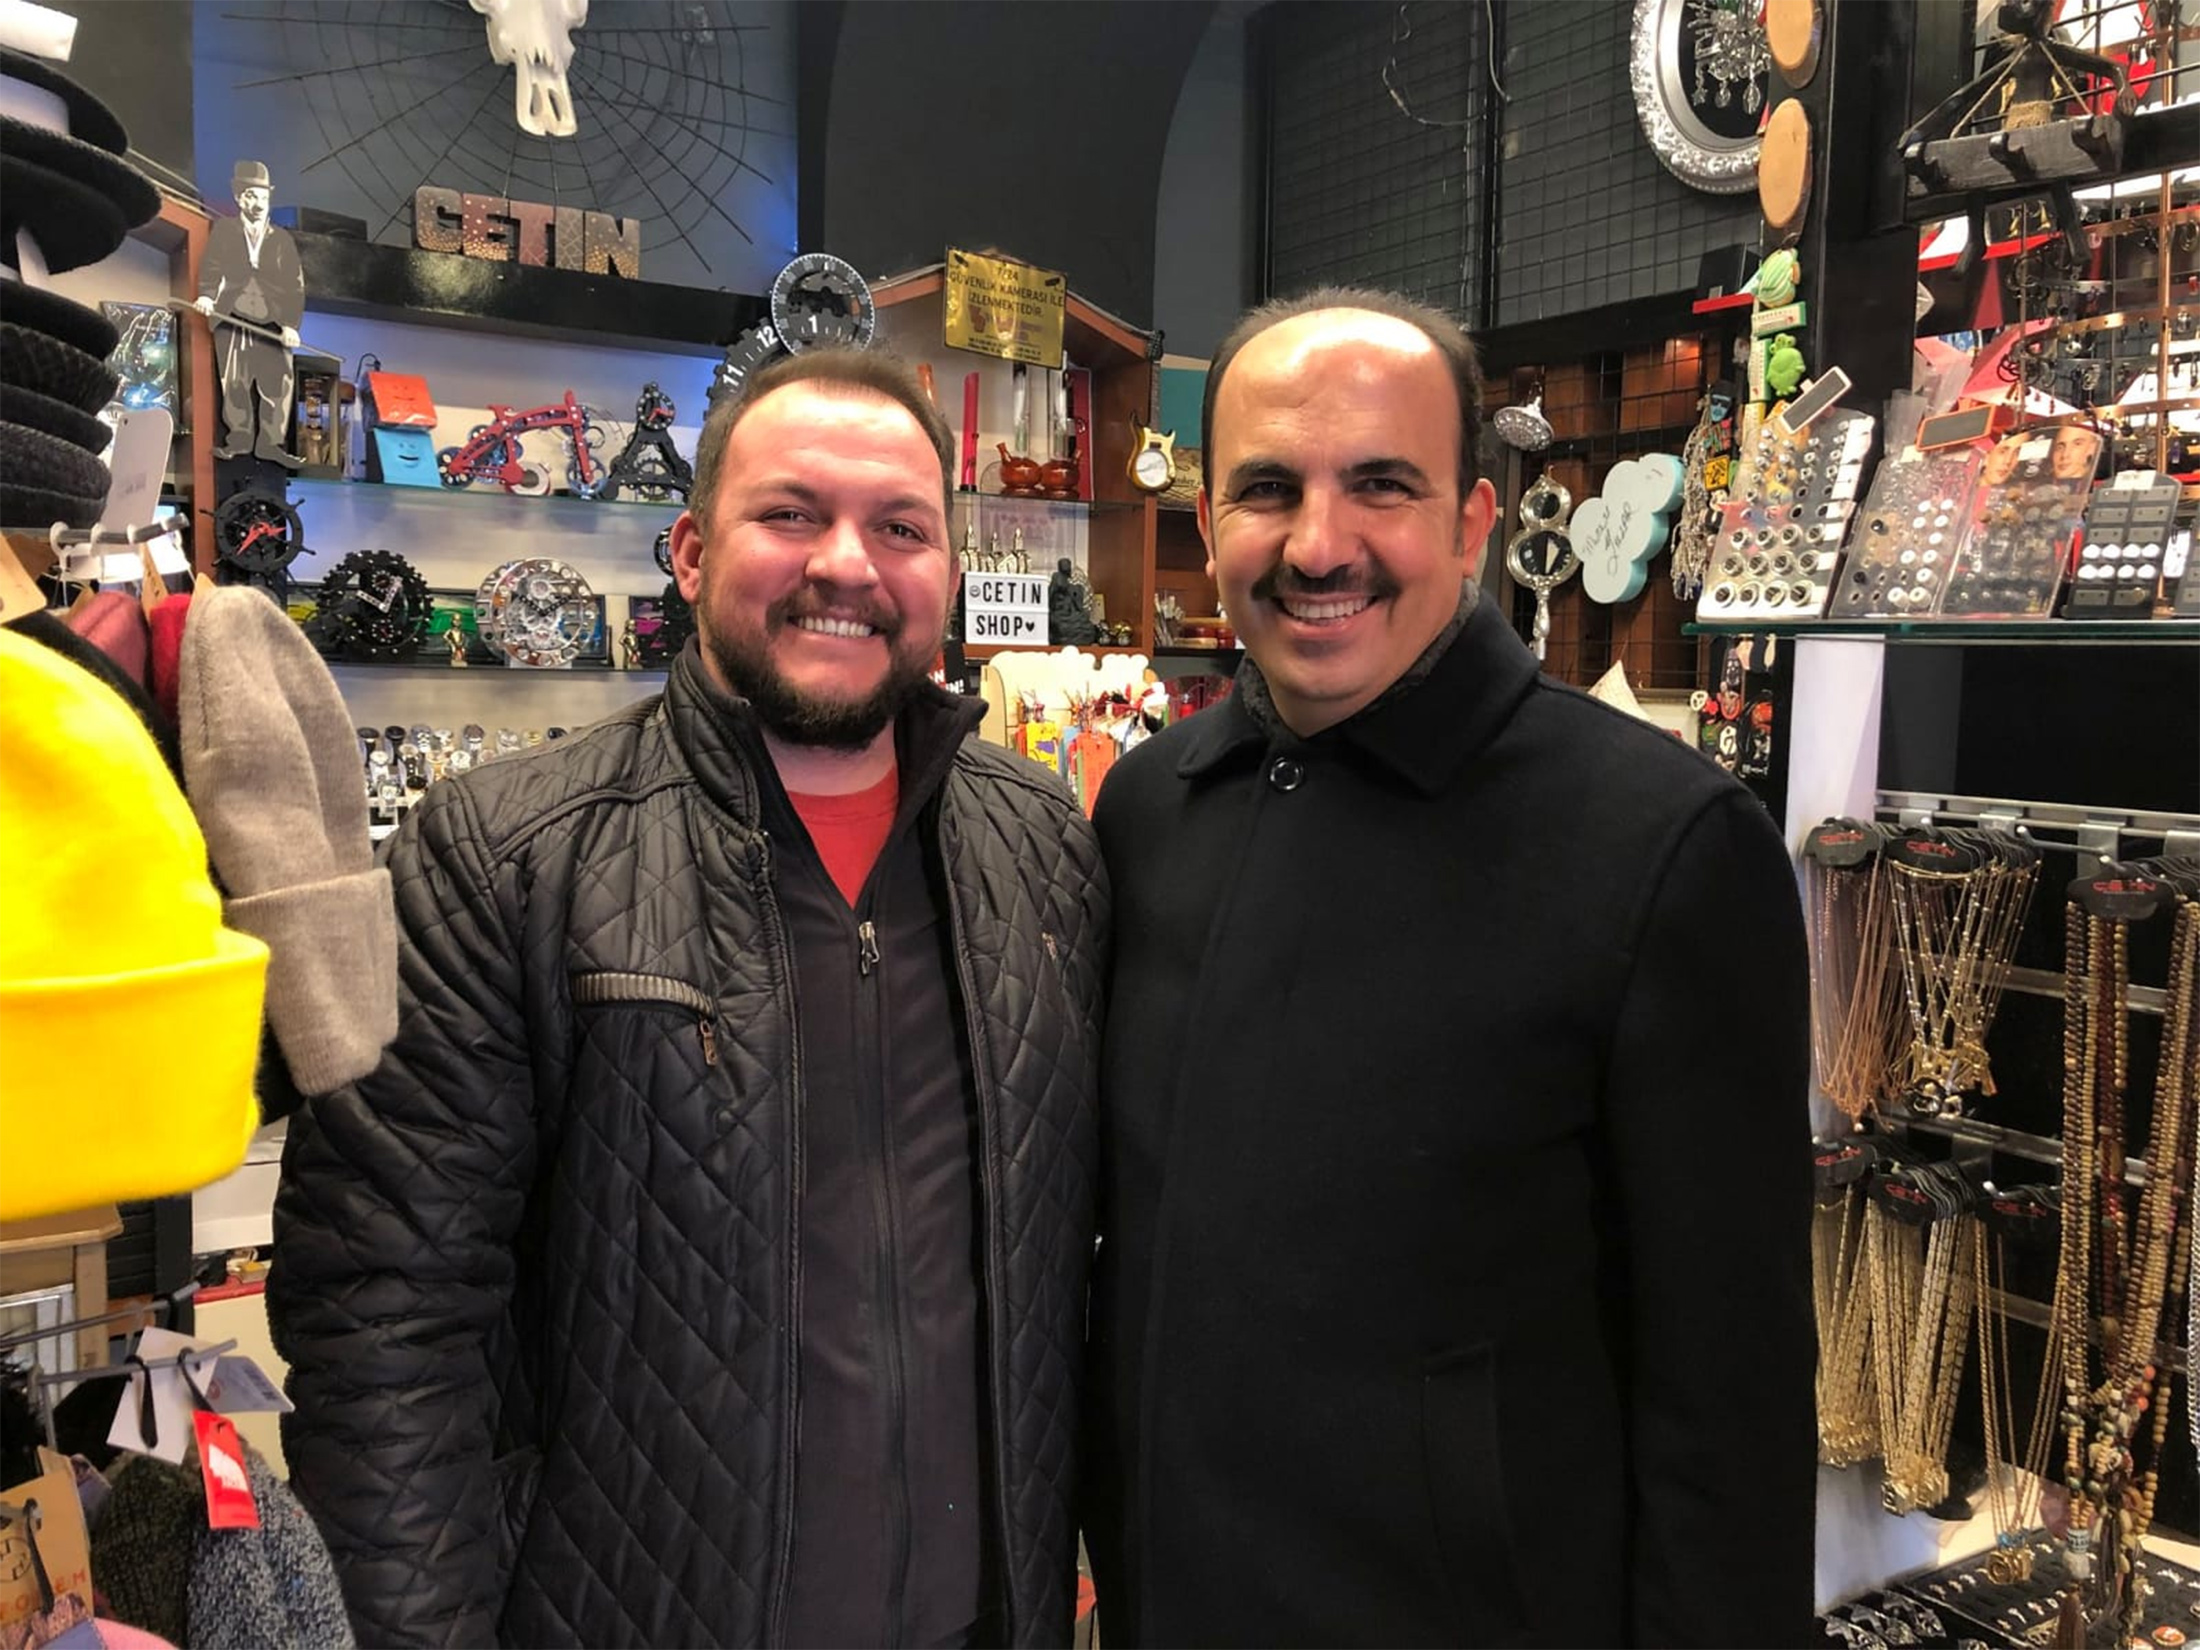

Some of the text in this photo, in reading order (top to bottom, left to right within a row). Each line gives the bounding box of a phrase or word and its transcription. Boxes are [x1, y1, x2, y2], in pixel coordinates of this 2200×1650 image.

[414, 185, 641, 280] CETIN
[1000, 283, 1048, 305] KAMERASI
[756, 325, 779, 348] 12
[722, 363, 744, 387] 11
[982, 581, 1042, 604] CETIN
